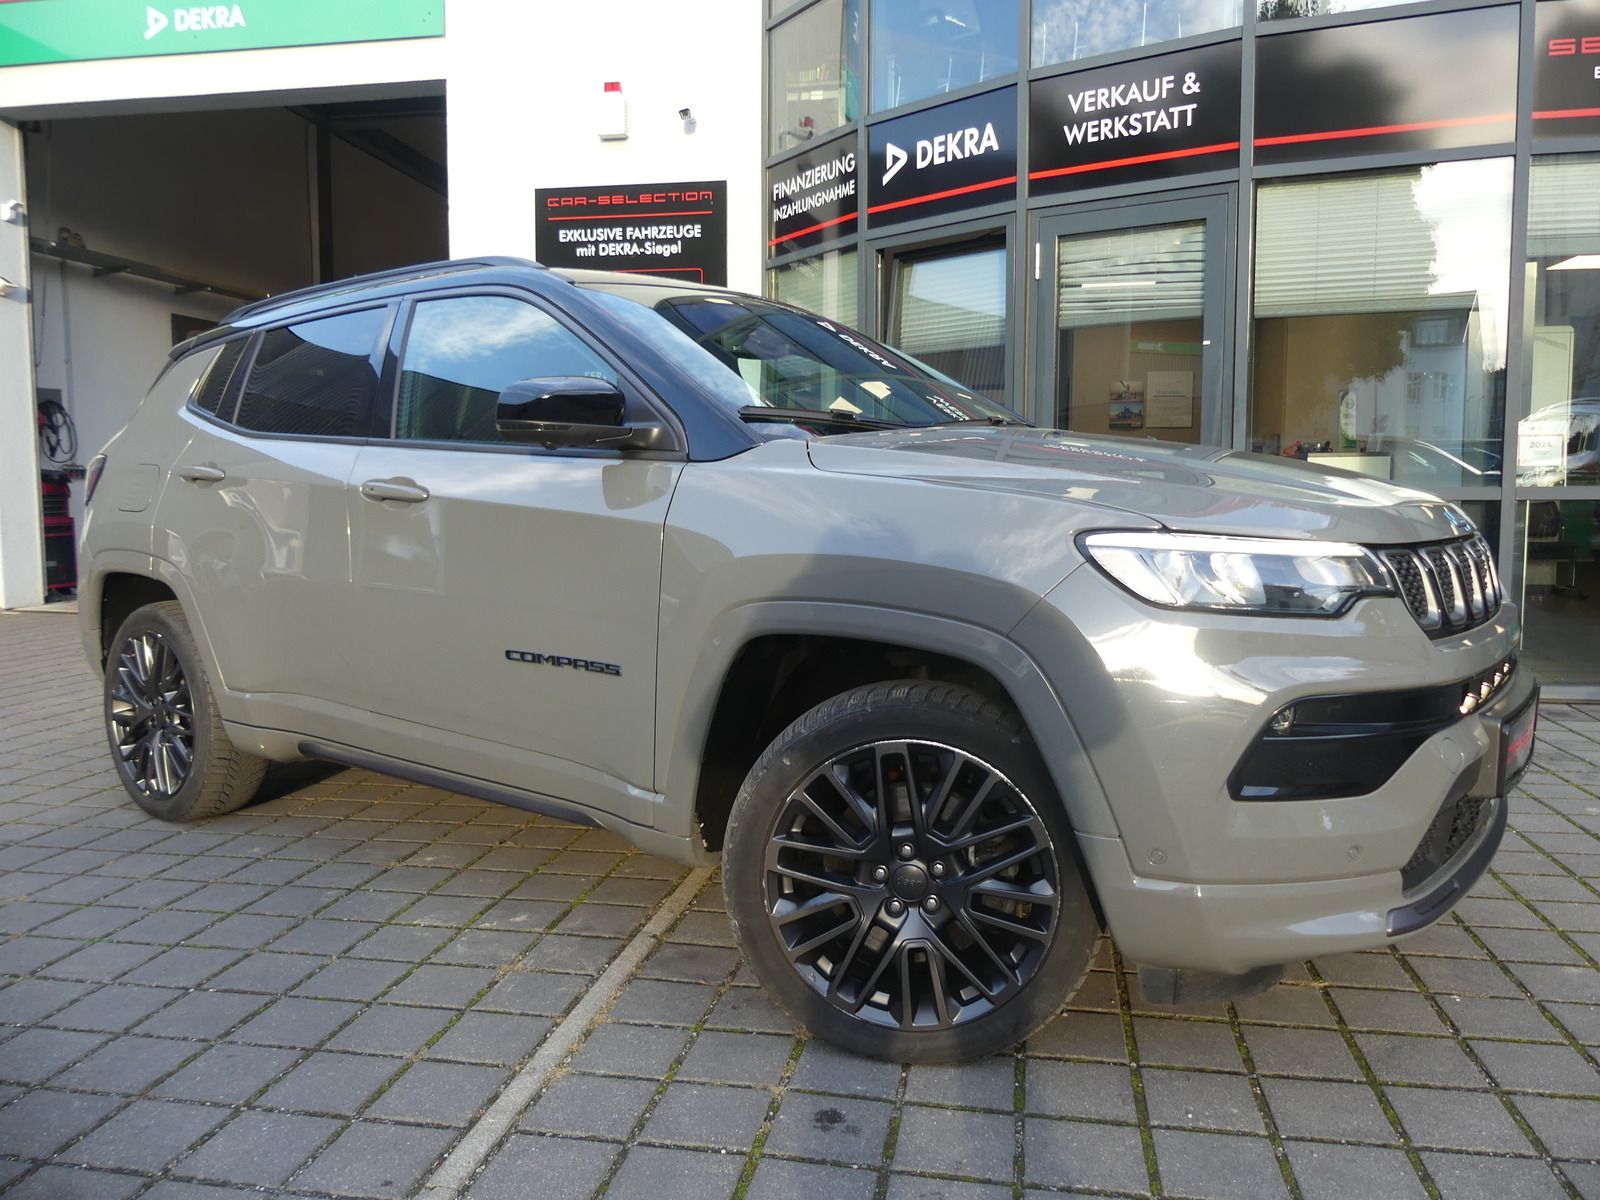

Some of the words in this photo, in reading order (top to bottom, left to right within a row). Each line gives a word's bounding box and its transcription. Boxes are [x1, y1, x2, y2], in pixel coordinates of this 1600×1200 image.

[174, 4, 246, 32] DEKRA
[1067, 76, 1174, 115] VERKAUF
[1182, 72, 1200, 95] &
[1063, 103, 1197, 146] WERKSTATT
[916, 122, 999, 170] DEKRA
[773, 152, 856, 202] FINANZIERUNG
[547, 191, 713, 208] CAR-SELECTION
[773, 179, 855, 223] INZAHLUNGNAHME
[558, 227, 623, 243] EXKLUSIVE
[626, 224, 702, 241] FAHRZEUGE
[576, 244, 596, 257] mit
[599, 241, 682, 258] DEKRA-Siegel
[505, 650, 623, 677] COMPASS
